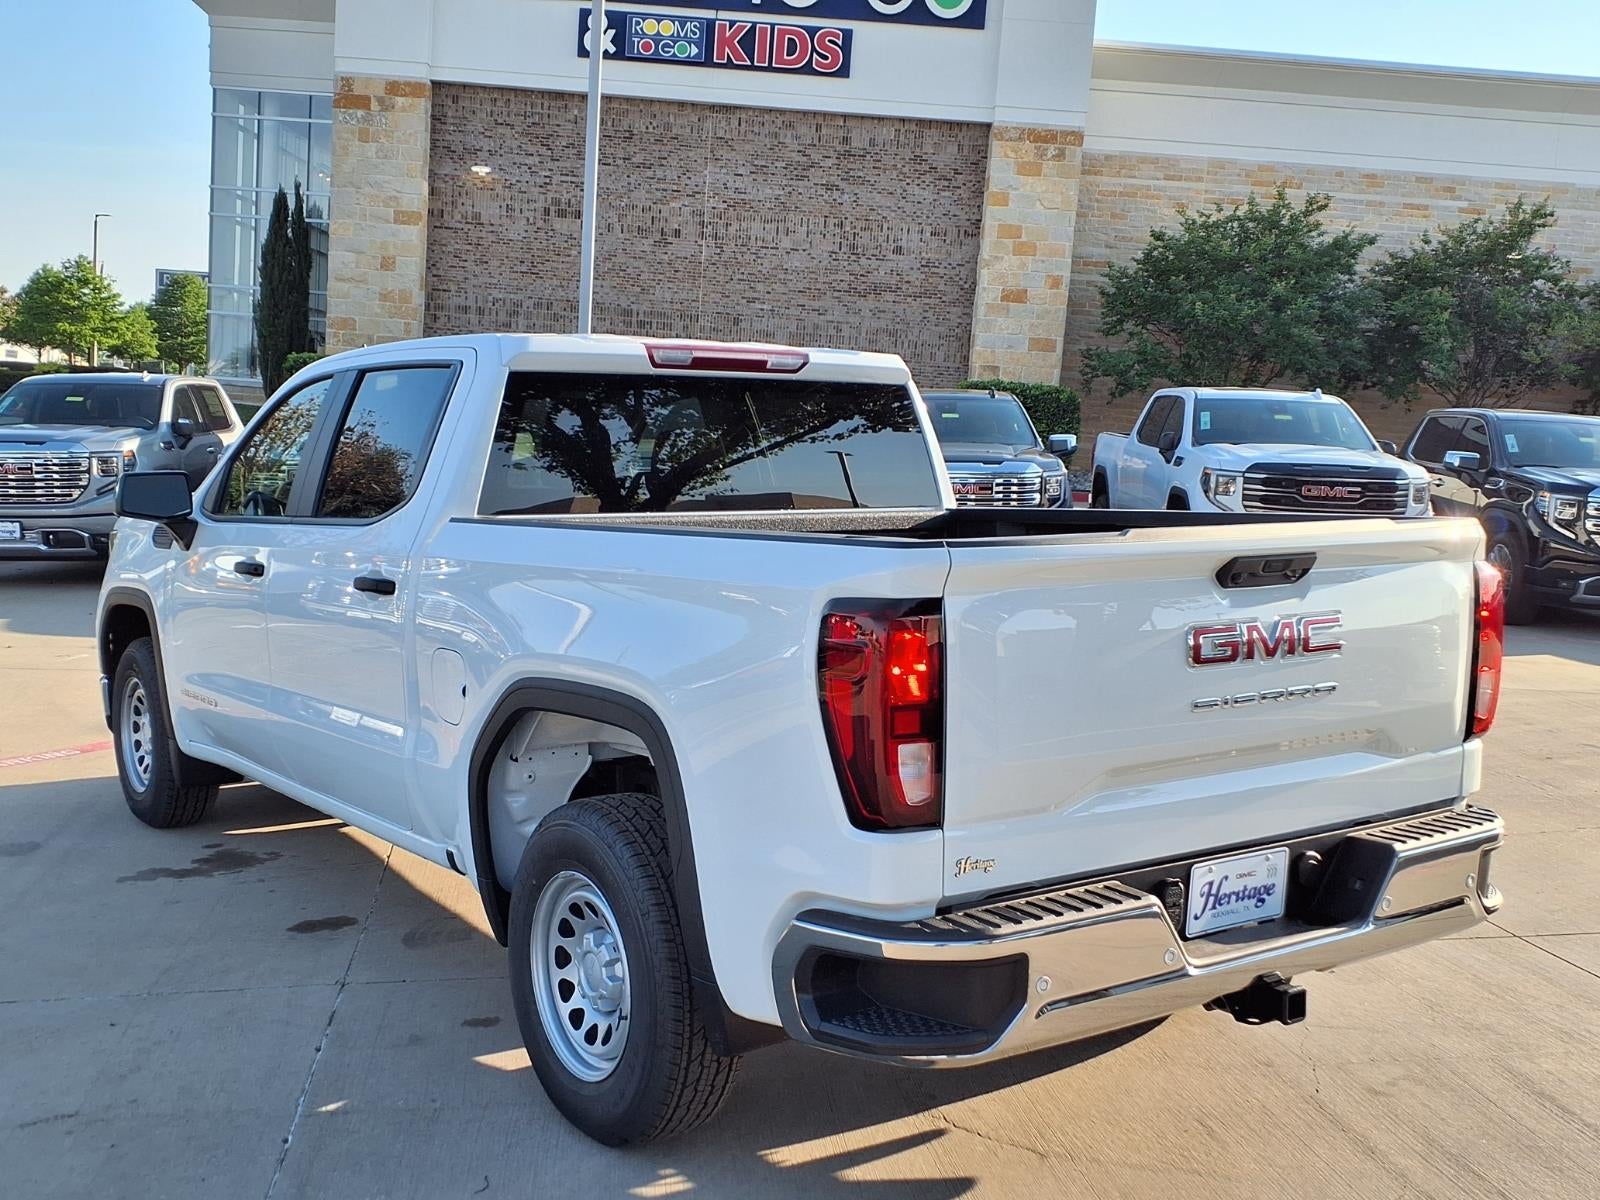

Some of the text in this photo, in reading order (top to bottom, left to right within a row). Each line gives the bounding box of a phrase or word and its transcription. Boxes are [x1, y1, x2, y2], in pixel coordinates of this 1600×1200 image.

[632, 17, 700, 38] ROOMS
[632, 37, 691, 58] TO GO
[713, 20, 844, 73] KIDS
[0, 463, 31, 474] MC
[953, 483, 992, 494] MC
[1301, 485, 1362, 498] GMC
[1186, 610, 1344, 671] GMC
[1191, 681, 1339, 712] SIERRA
[1193, 875, 1276, 921] Heritage
